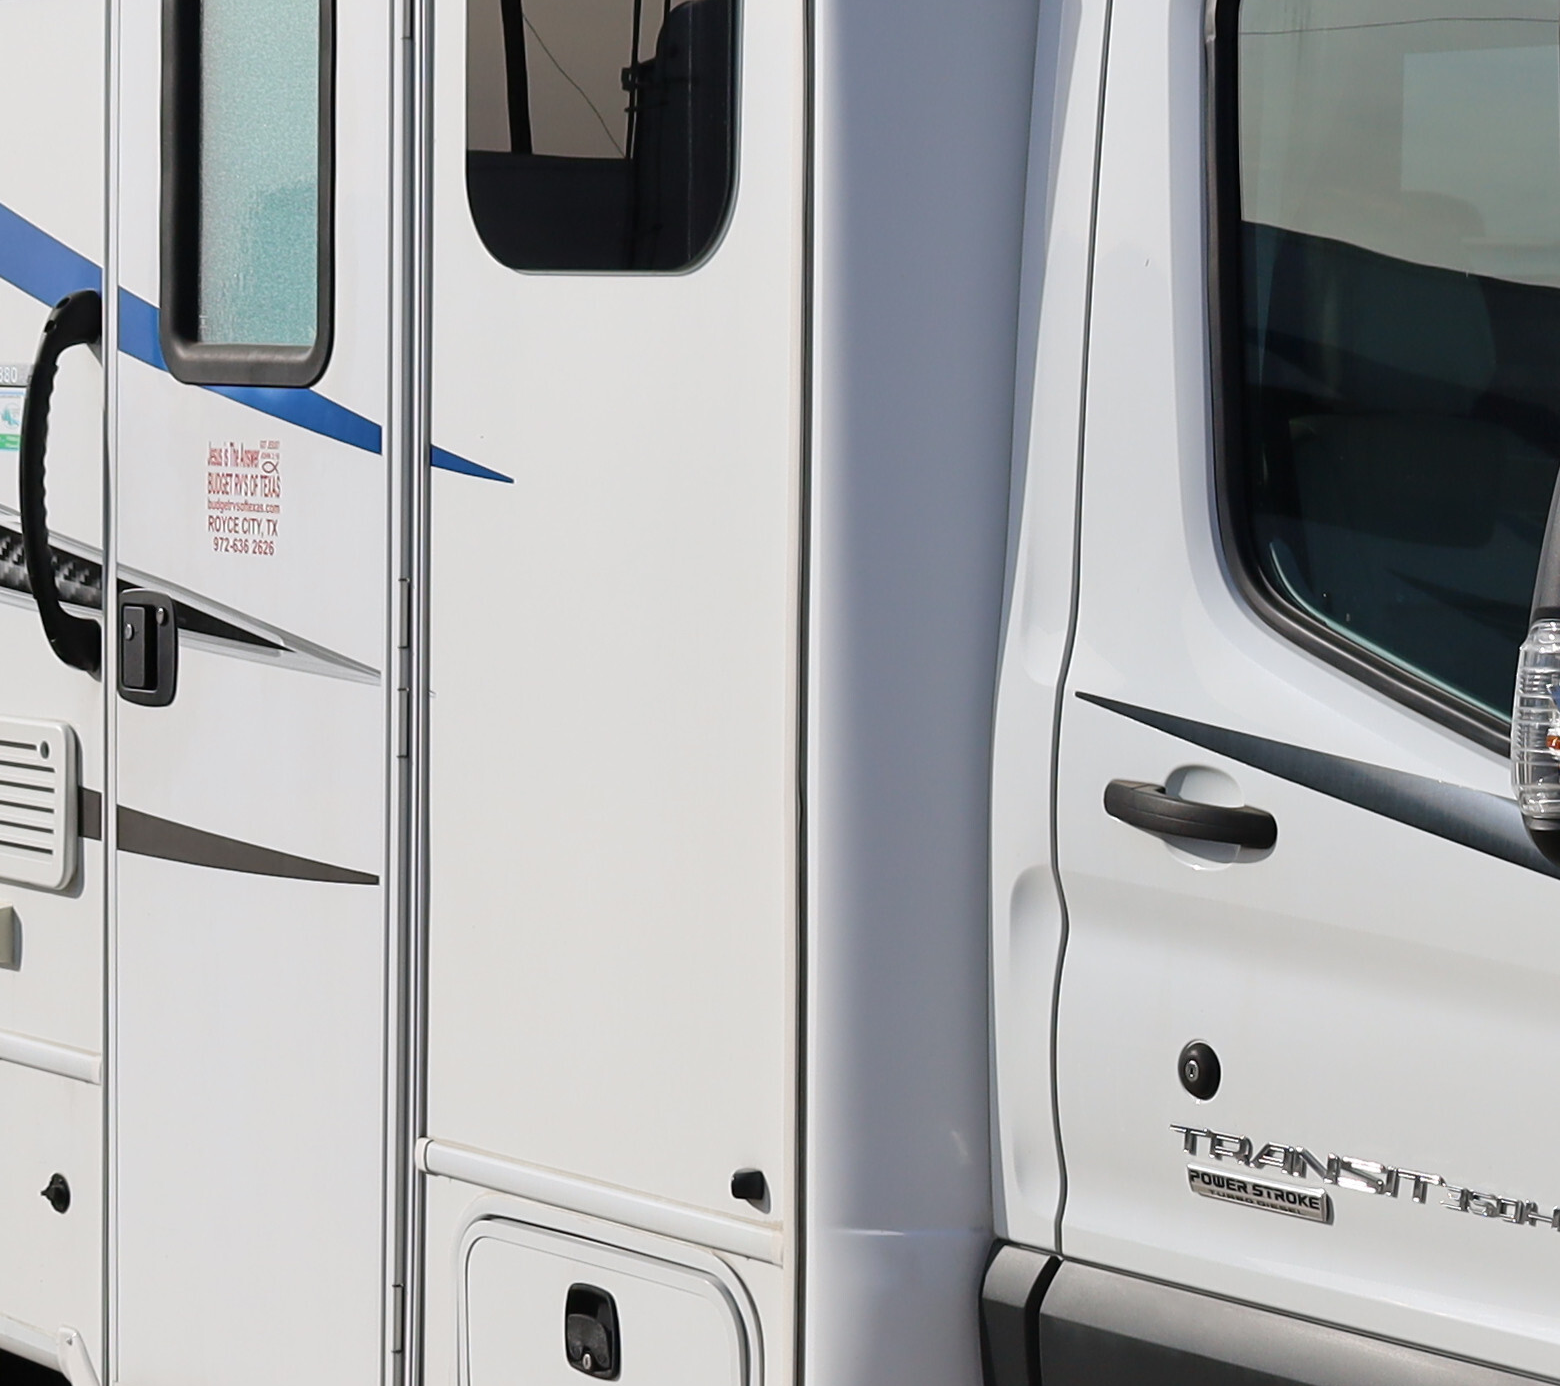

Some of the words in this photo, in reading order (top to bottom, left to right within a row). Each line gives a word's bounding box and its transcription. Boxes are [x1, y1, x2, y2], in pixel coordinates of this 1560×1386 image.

[207, 471, 233, 495] BUDGET
[250, 474, 259, 497] OF
[260, 474, 281, 498] TEXAS
[208, 515, 240, 534] ROYCE
[241, 517, 264, 538] CITY,
[266, 519, 279, 536] TX
[213, 536, 249, 553] 972-636
[252, 539, 275, 556] 2626
[1169, 1123, 1445, 1204] TRANSIT
[1190, 1169, 1248, 1198] POWER
[1252, 1185, 1321, 1211] STROKE
